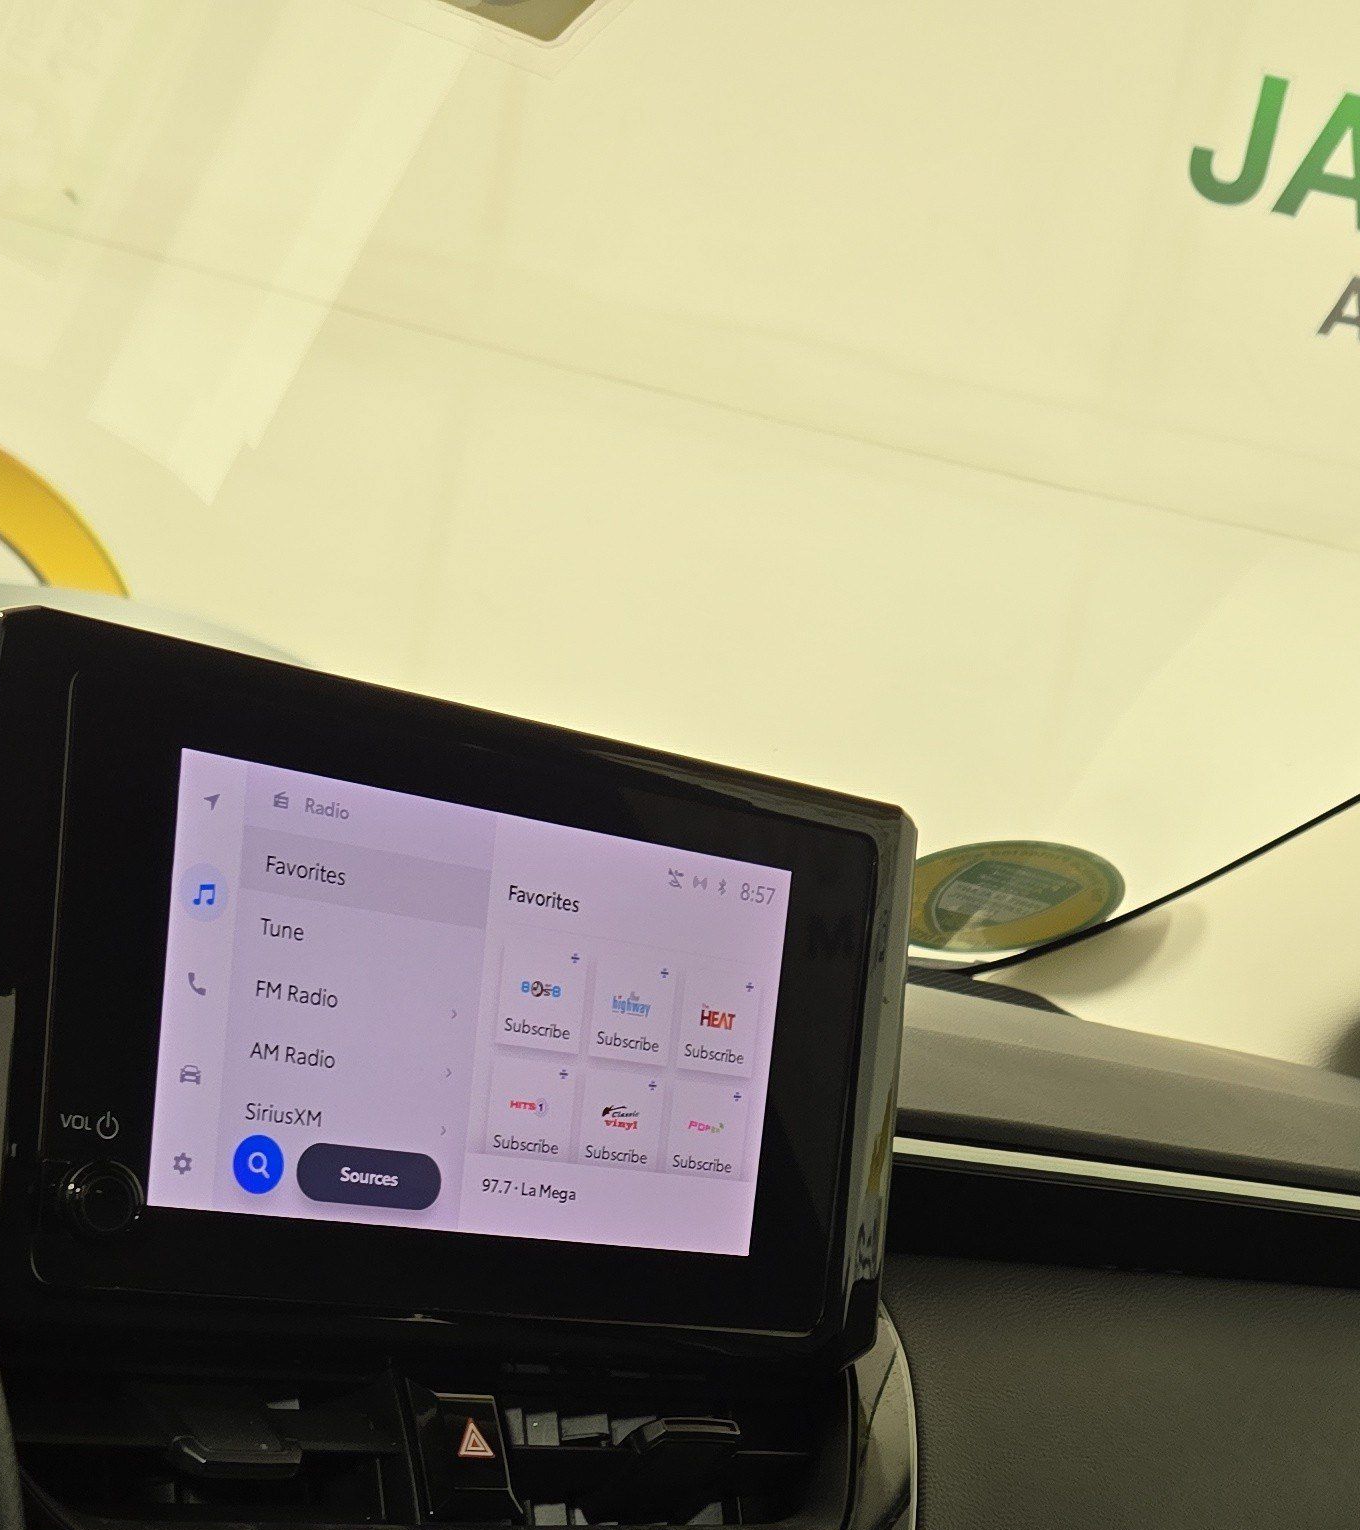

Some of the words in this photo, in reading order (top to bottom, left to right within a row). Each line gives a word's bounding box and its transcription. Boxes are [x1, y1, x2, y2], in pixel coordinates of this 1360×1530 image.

[304, 797, 350, 820] Radio
[265, 855, 346, 886] Favorites
[508, 884, 580, 912] Favorites
[740, 882, 776, 905] 8:57
[260, 917, 305, 941] Tune
[255, 979, 282, 1000] FM
[287, 985, 338, 1008] Radio
[611, 996, 651, 1018] highway
[700, 1009, 736, 1030] HEAT
[504, 1017, 570, 1040] Subscribe
[597, 1030, 659, 1053] Subscribe
[684, 1043, 744, 1065] Subscribe
[250, 1042, 279, 1061] AM
[285, 1046, 335, 1069] Radio
[245, 1103, 322, 1127] SiriusXM
[509, 1100, 536, 1111] HITS
[60, 1113, 92, 1131] VOL
[604, 1119, 638, 1131] vinyl
[493, 1134, 558, 1155] Subscribe
[585, 1145, 647, 1165] Subscribe
[672, 1154, 732, 1173] Subscribe
[340, 1167, 399, 1187] Sources
[482, 1178, 512, 1195] 97.7
[521, 1182, 536, 1197] La
[539, 1184, 576, 1203] Mega
